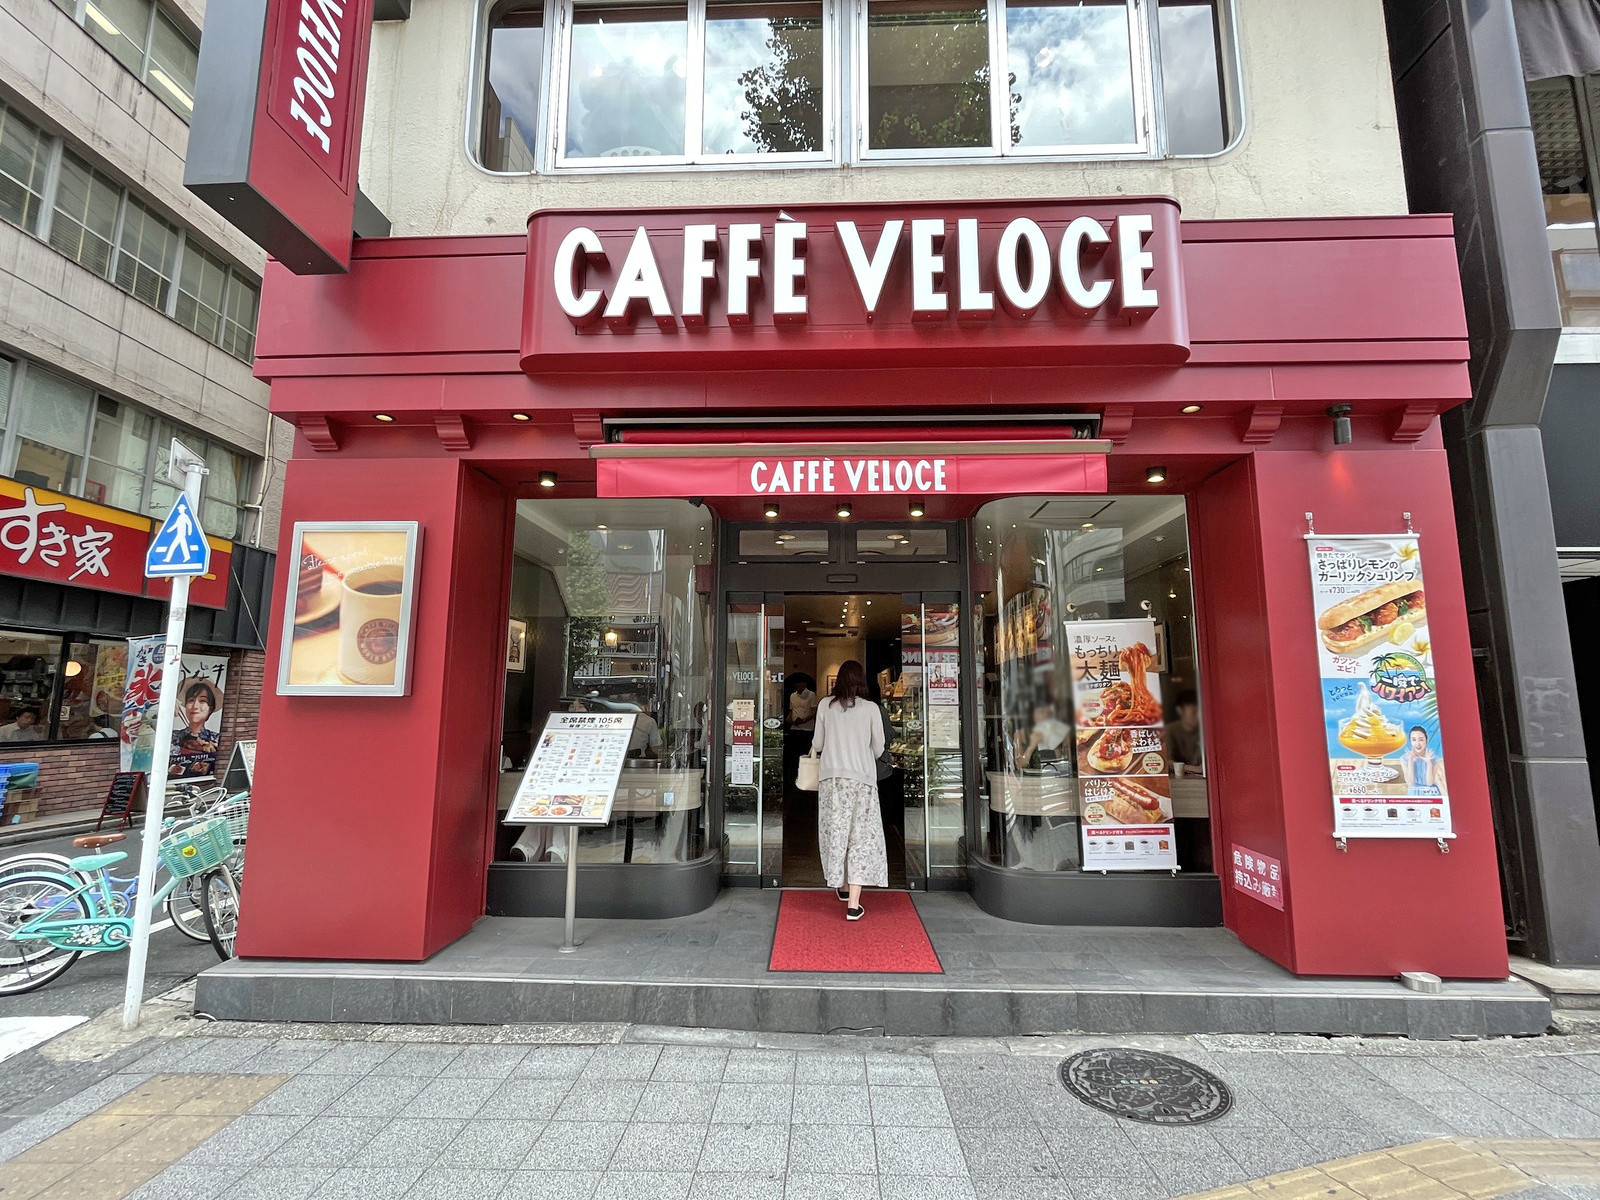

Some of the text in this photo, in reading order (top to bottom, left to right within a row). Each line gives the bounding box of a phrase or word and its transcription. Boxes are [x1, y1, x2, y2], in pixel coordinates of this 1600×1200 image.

[553, 210, 1160, 317] CAFFÈ VELOCE
[750, 456, 947, 494] CAFFÈ VELOCE
[0, 487, 114, 581] すき家
[1317, 559, 1398, 570] さっぱりレモンの
[1318, 570, 1417, 582] ガーリックシュリンプ
[1329, 586, 1345, 594] ¥730
[1074, 635, 1116, 644] 濃厚ソースと
[1075, 645, 1118, 659] もっちり
[732, 671, 755, 680] VELOCE
[1076, 660, 1121, 681] 太麺
[733, 729, 752, 737] Wi-Fi
[1085, 788, 1115, 796] はじける
